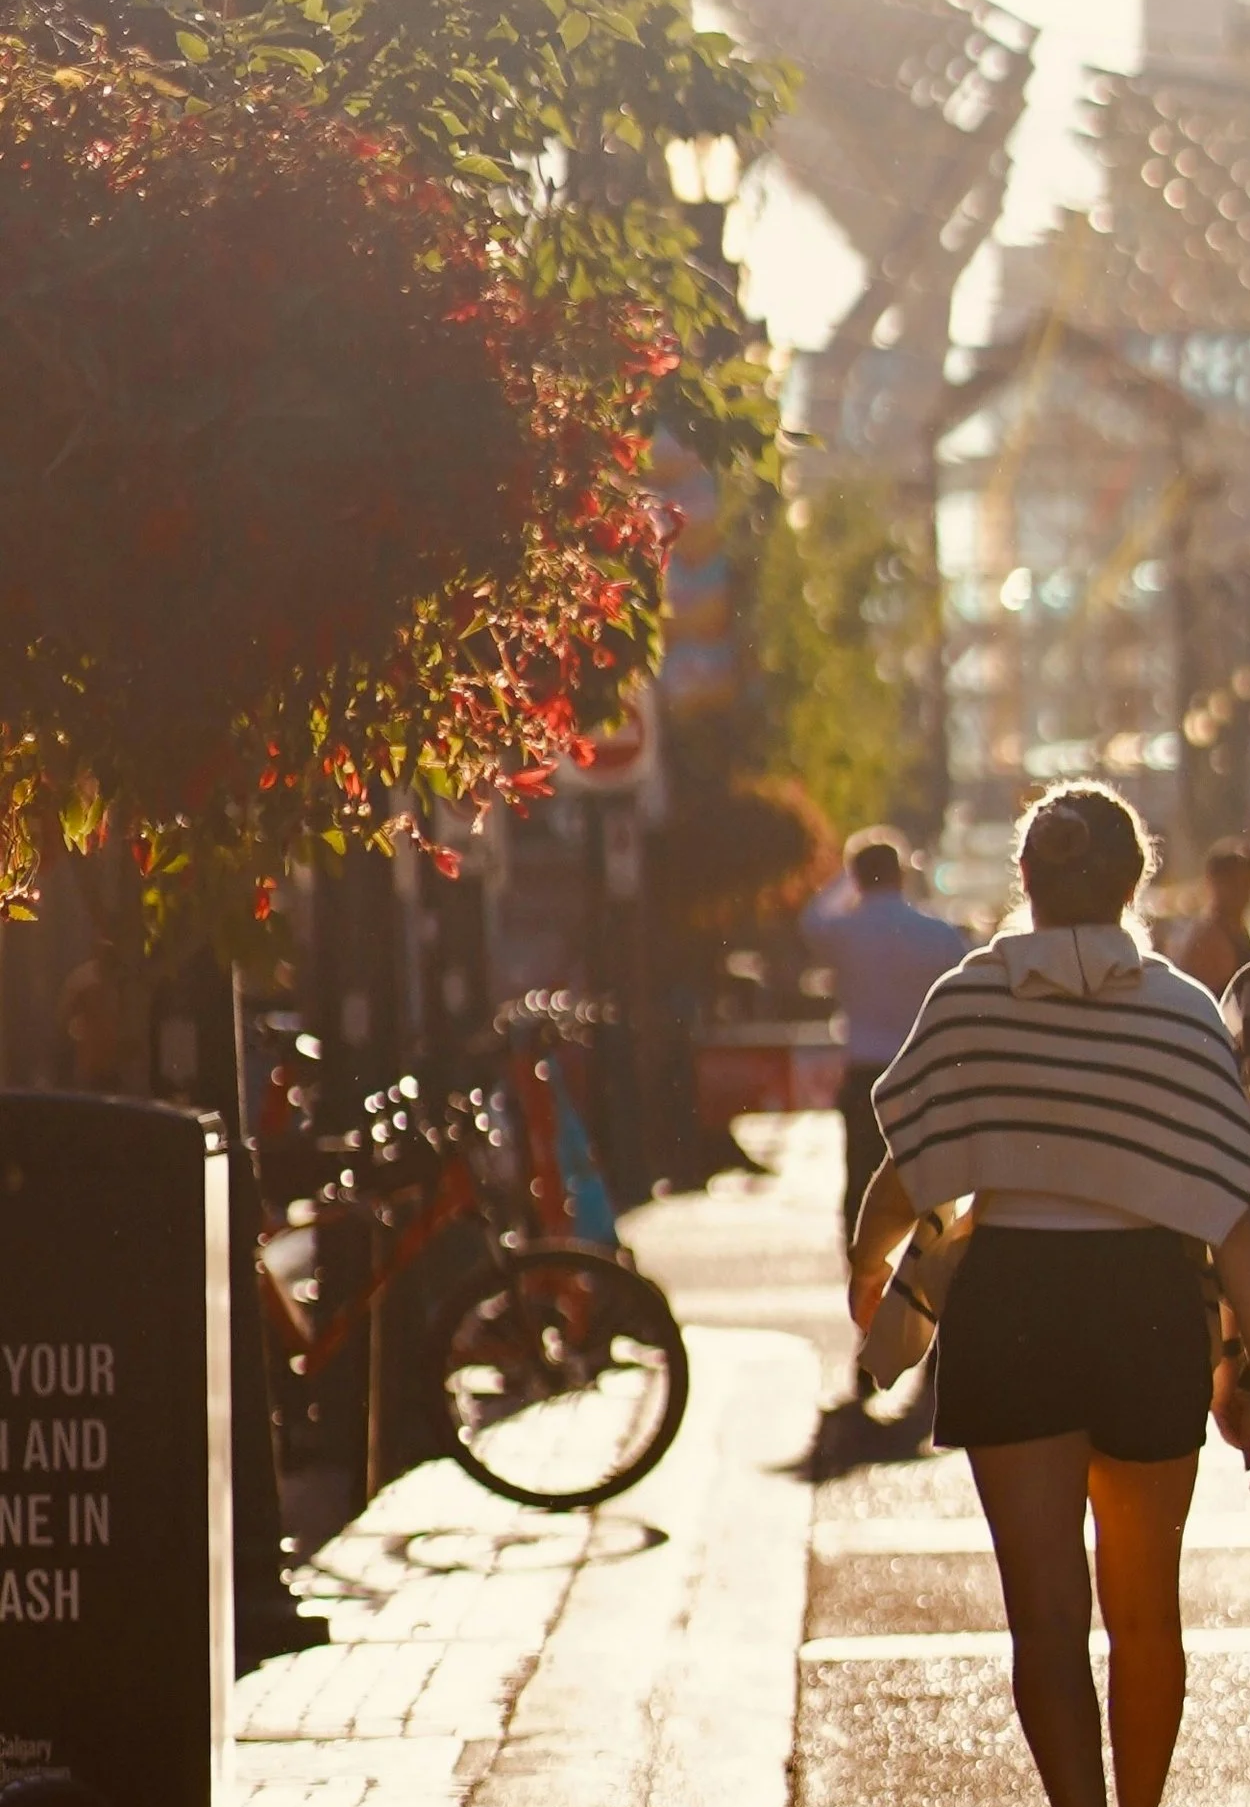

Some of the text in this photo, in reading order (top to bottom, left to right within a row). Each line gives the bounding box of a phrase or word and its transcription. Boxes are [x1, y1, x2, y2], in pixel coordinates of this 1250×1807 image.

[2, 1343, 115, 1396] YOUR
[22, 1418, 109, 1472] AND
[68, 1493, 110, 1546] IN
